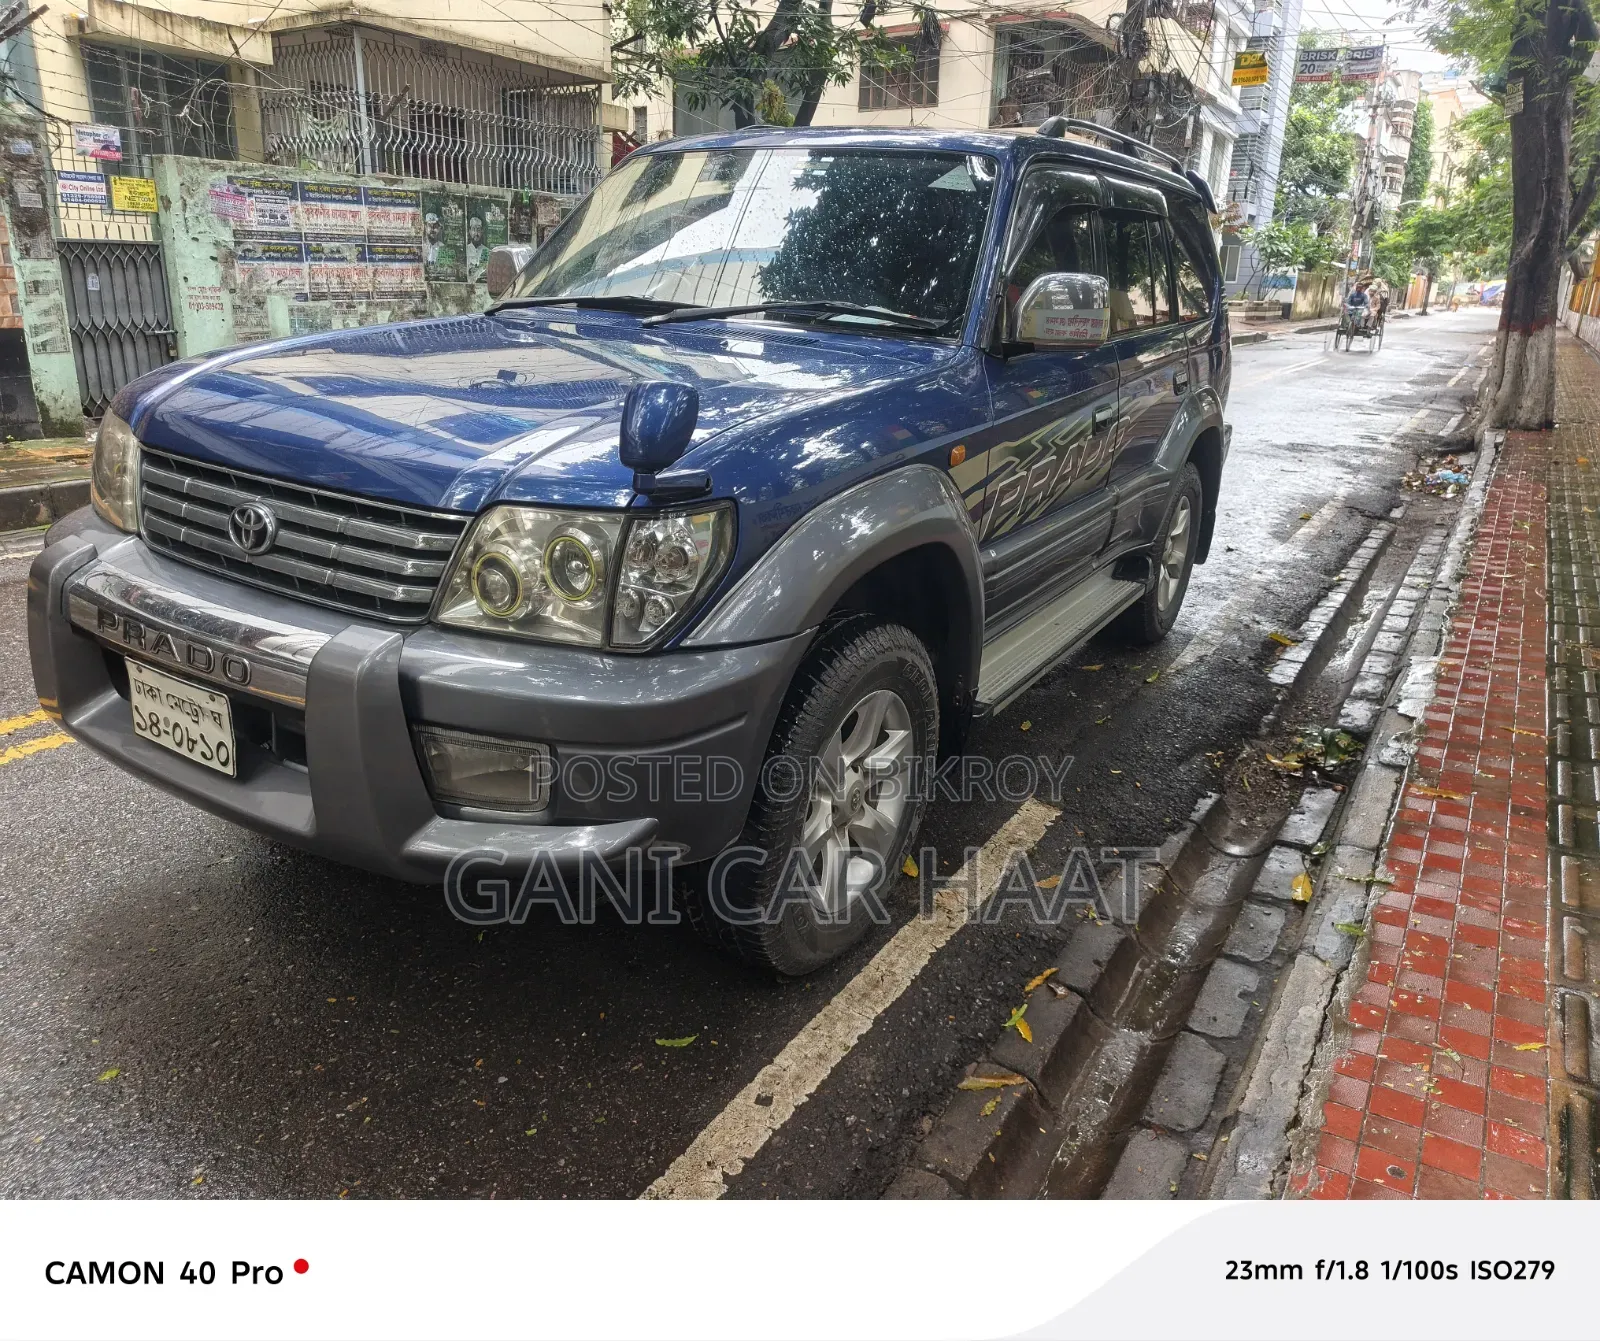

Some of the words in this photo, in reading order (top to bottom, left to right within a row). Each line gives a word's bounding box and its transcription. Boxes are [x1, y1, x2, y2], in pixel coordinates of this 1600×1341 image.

[1300, 51, 1337, 60] BRISK
[1300, 63, 1316, 75] 20
[68, 184, 79, 192] City
[80, 184, 95, 192] Online
[97, 605, 252, 686] PRADO
[133, 678, 163, 706] ঢাকা
[166, 693, 204, 726] মেট্রো
[134, 704, 230, 767] ১৪-০৮১০
